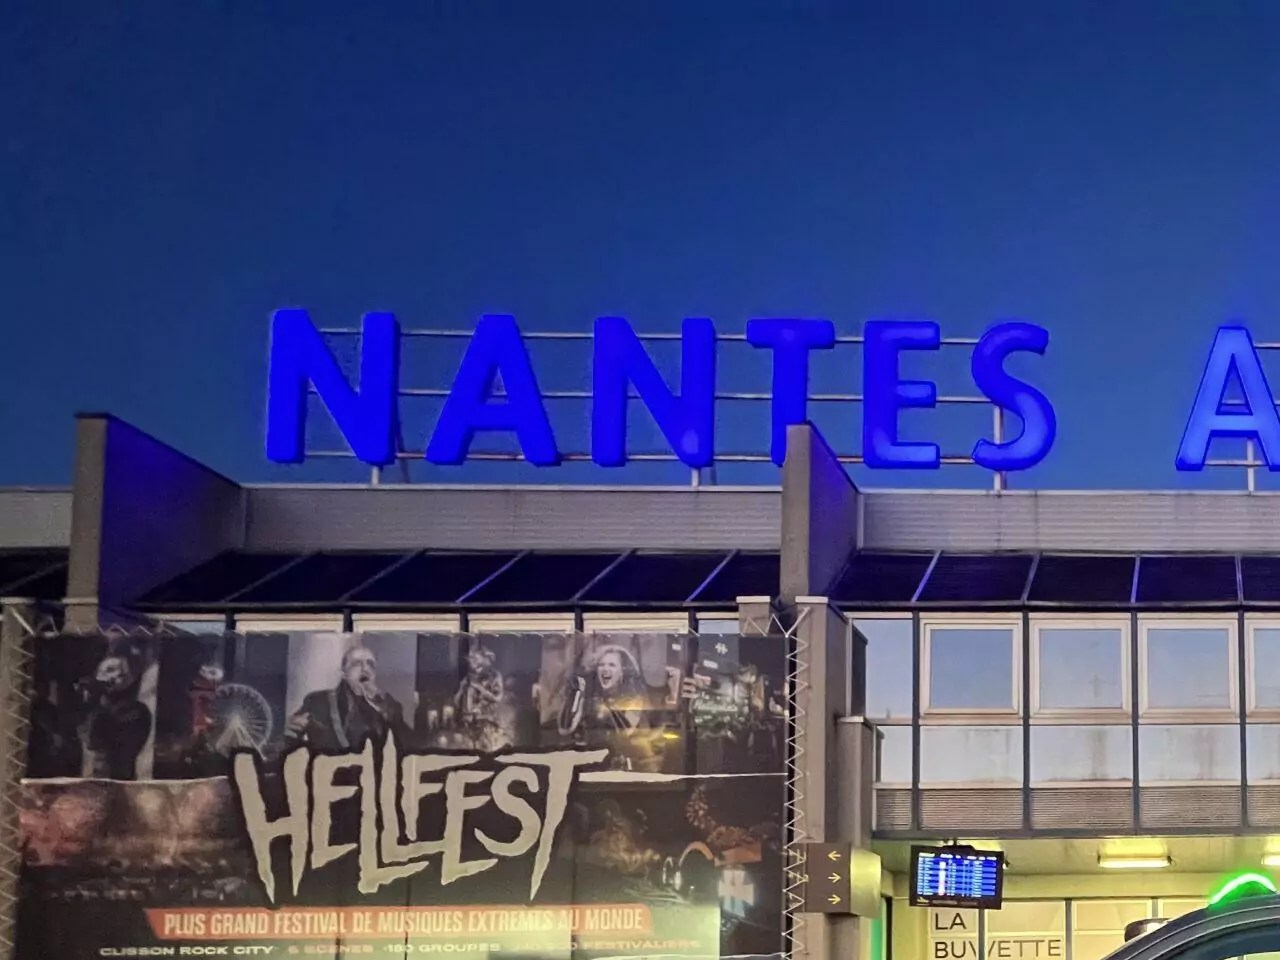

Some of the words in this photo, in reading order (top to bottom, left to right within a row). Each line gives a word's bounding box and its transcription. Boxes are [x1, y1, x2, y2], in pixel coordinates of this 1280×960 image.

[265, 308, 1057, 471] NANTES
[233, 728, 609, 903] HELLFEST
[163, 912, 206, 936] PLUS
[210, 912, 269, 935] GRAND
[273, 911, 347, 934] FESTIVAL
[352, 911, 373, 933] DE
[377, 910, 463, 933] MUSIQUES
[557, 909, 580, 931] AU
[584, 908, 644, 931] MONDE
[934, 912, 967, 930] LA
[178, 946, 229, 956] ROCK
[232, 945, 274, 956] CITY
[418, 942, 500, 953] GROUPES
[934, 939, 1062, 959] BUVETTE
